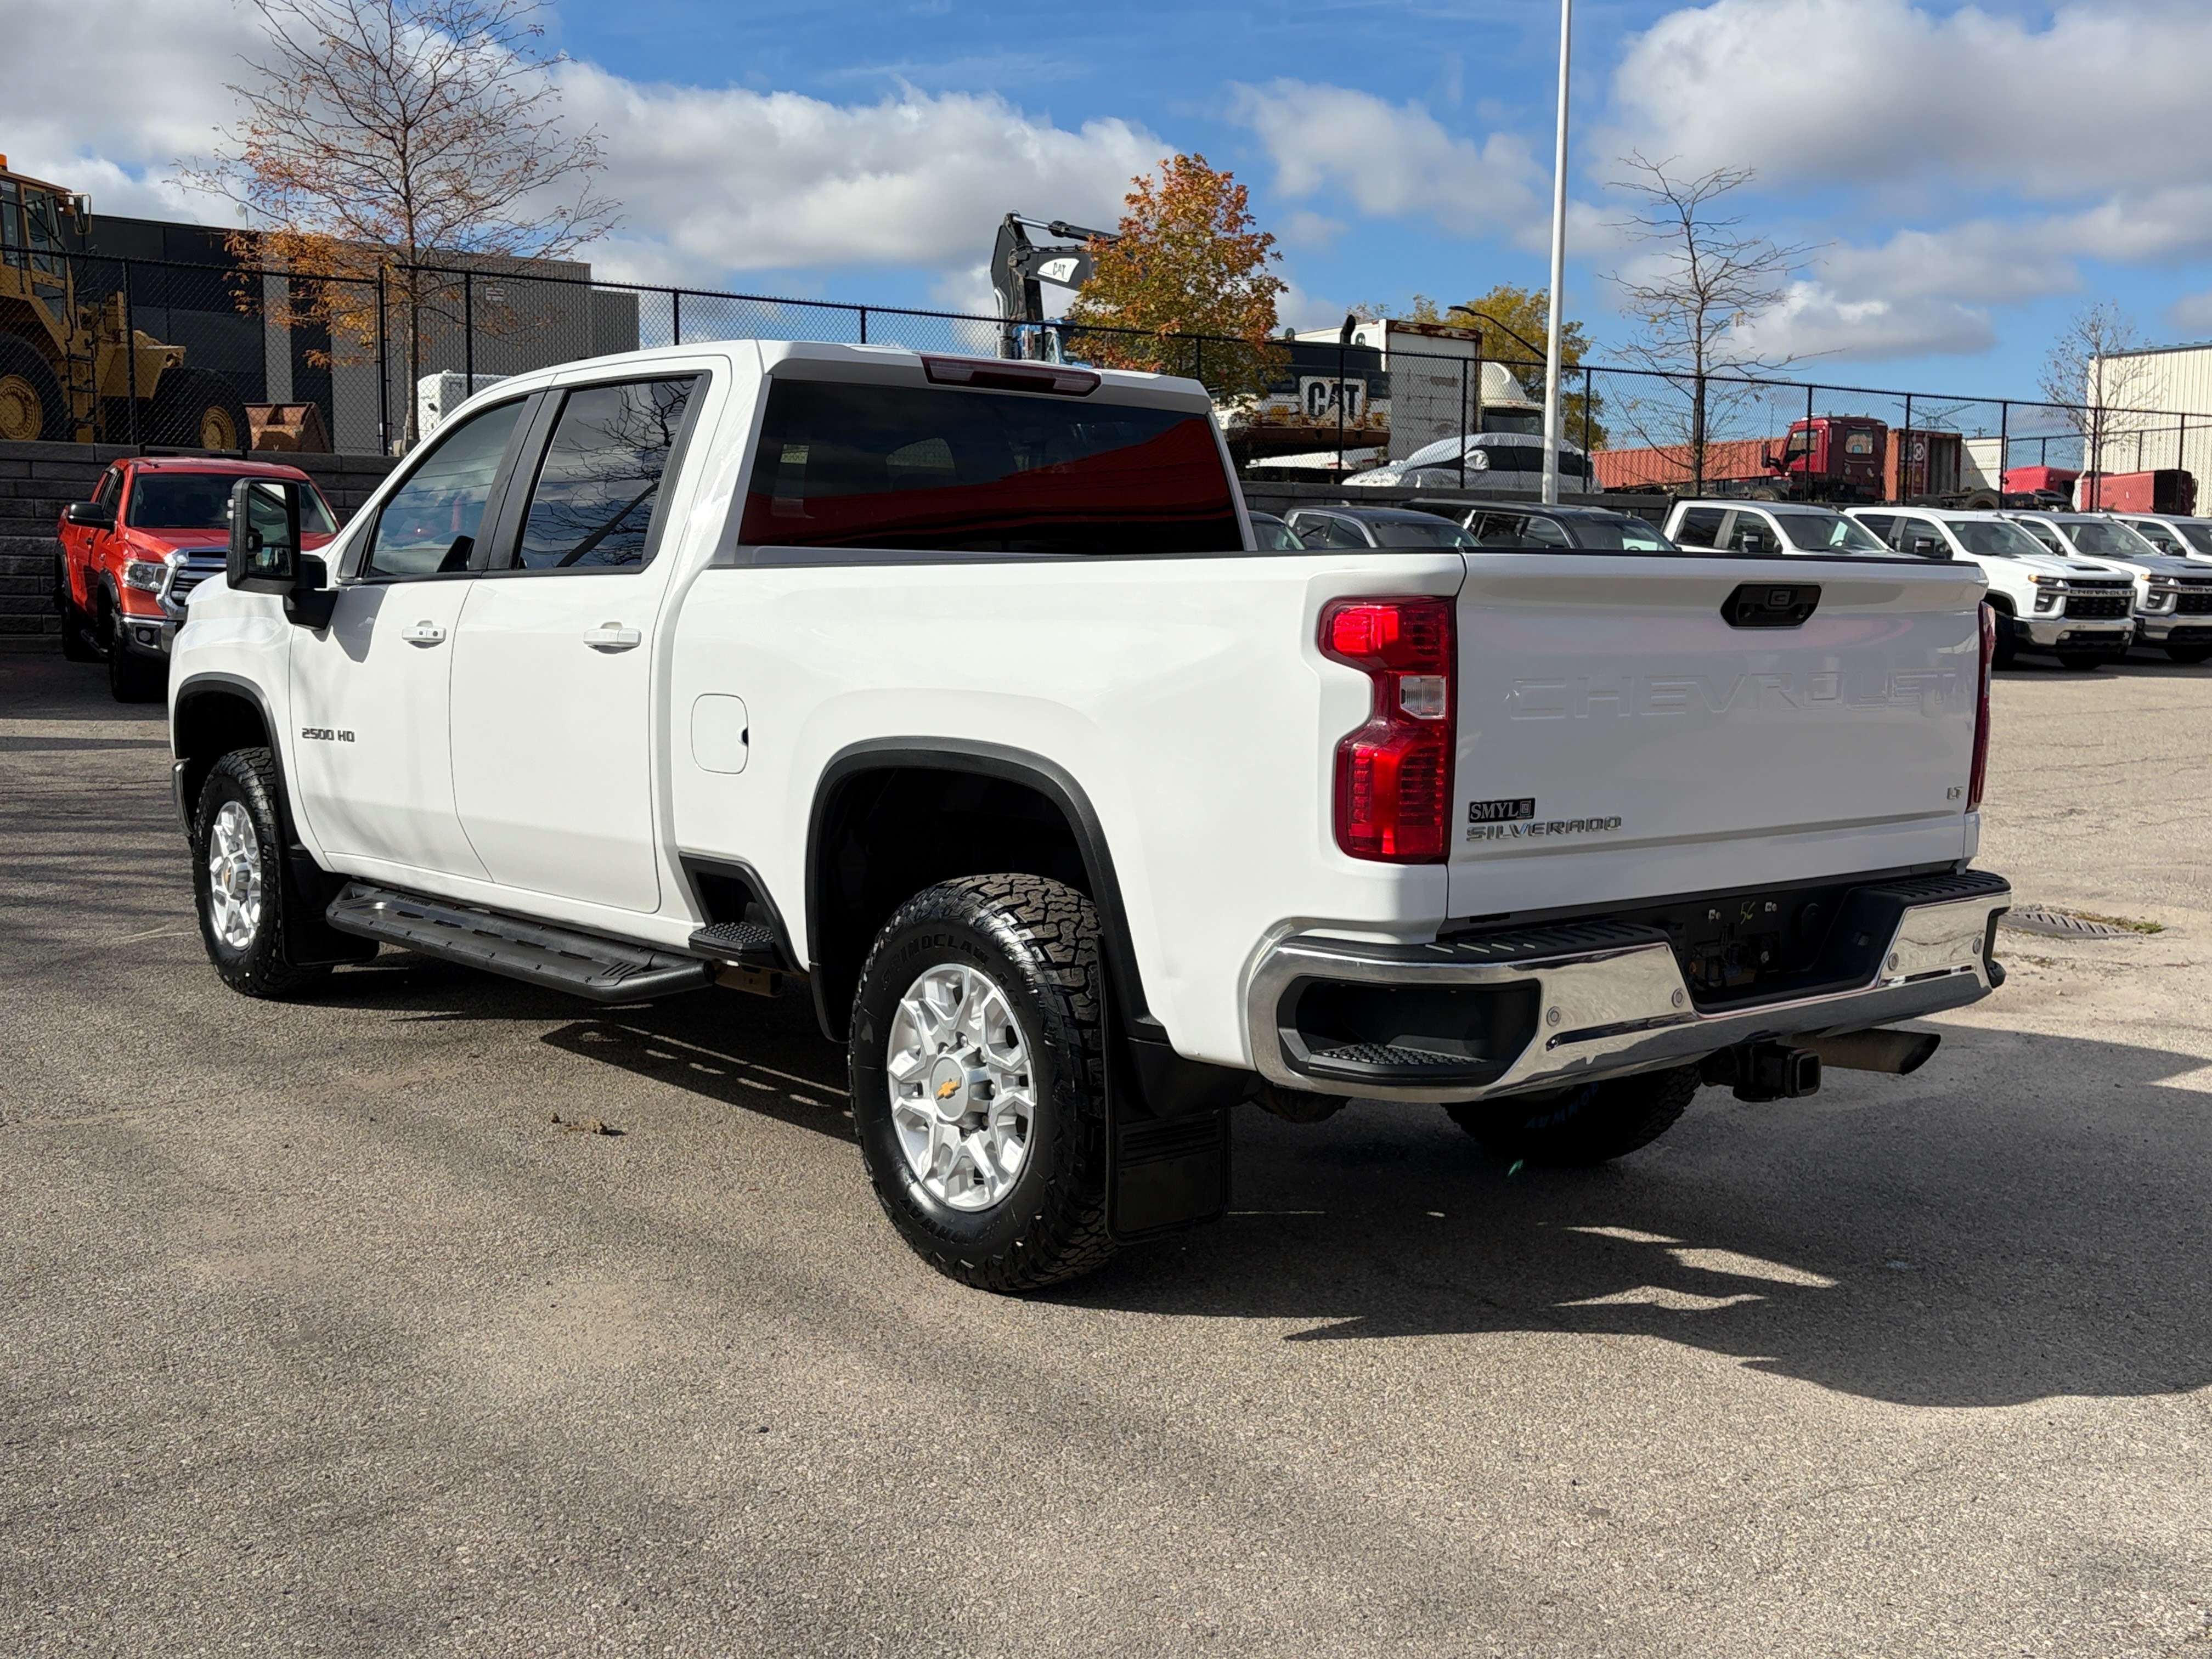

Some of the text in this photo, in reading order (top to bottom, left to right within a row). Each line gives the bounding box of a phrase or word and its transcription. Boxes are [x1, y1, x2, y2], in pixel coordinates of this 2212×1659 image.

[1053, 262, 1066, 279] CAT
[1308, 382, 1359, 423] CAT
[1510, 668, 1955, 720] CHEVROLET
[302, 727, 355, 742] 2500 HD
[1946, 786, 1965, 799] LT
[1466, 815, 1622, 842] SILVERADO
